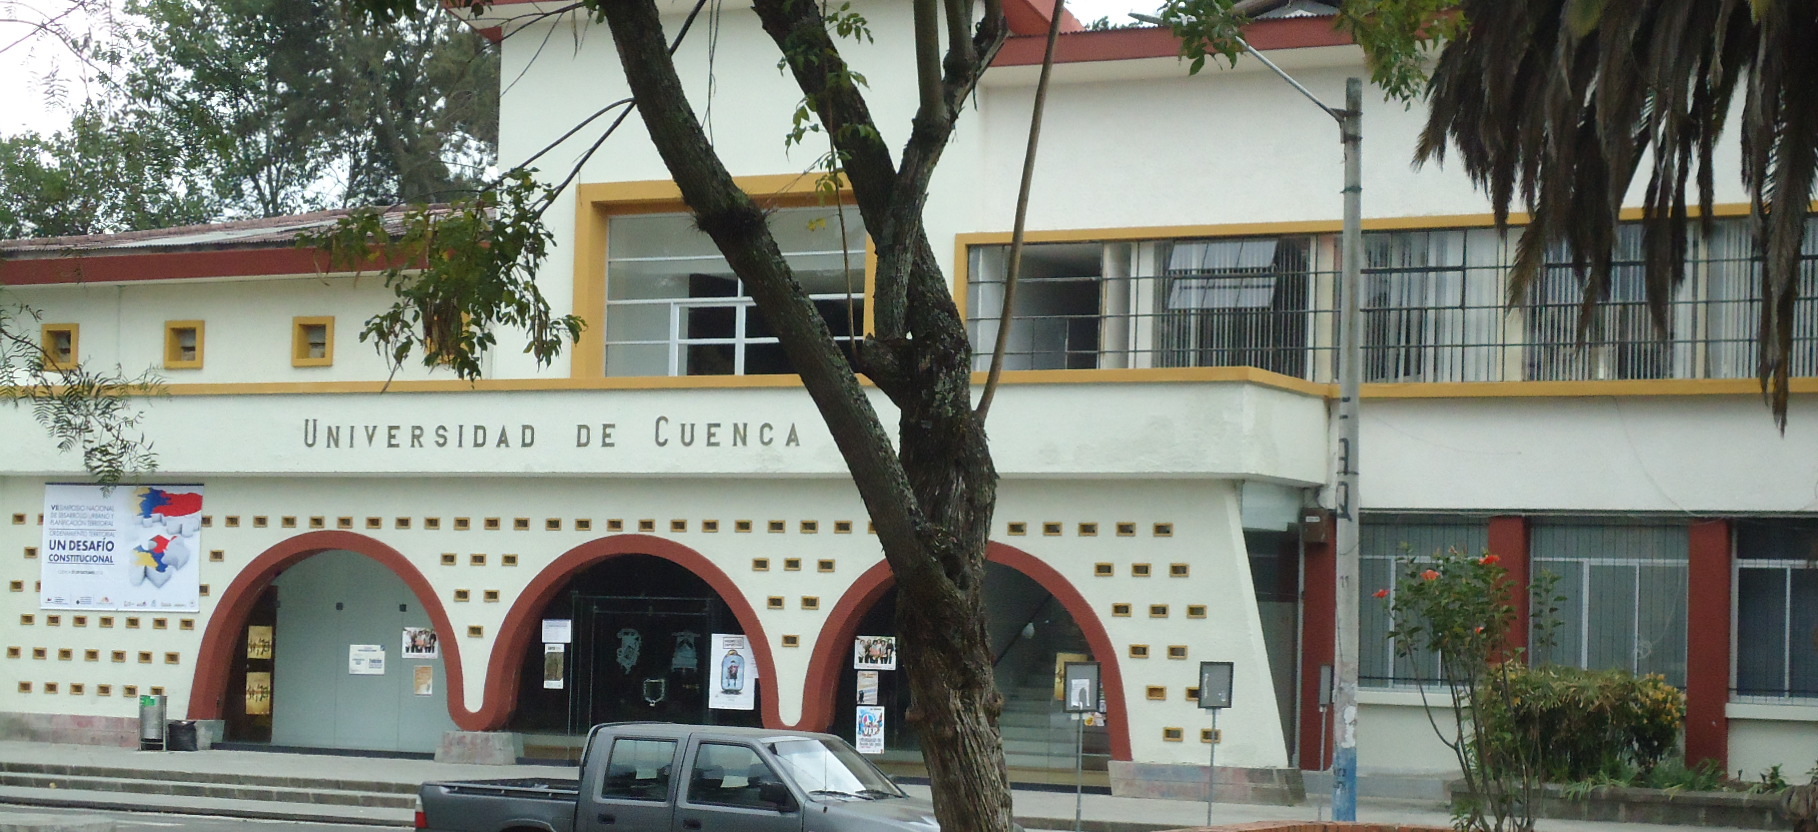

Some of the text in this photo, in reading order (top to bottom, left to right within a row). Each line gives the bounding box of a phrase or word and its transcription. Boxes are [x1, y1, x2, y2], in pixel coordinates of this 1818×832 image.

[303, 415, 801, 449] UNIVERSIDAD DE CUENCA
[49, 537, 115, 552] UN DESAFÍO
[48, 553, 114, 563] CONSTITUCIONAL
